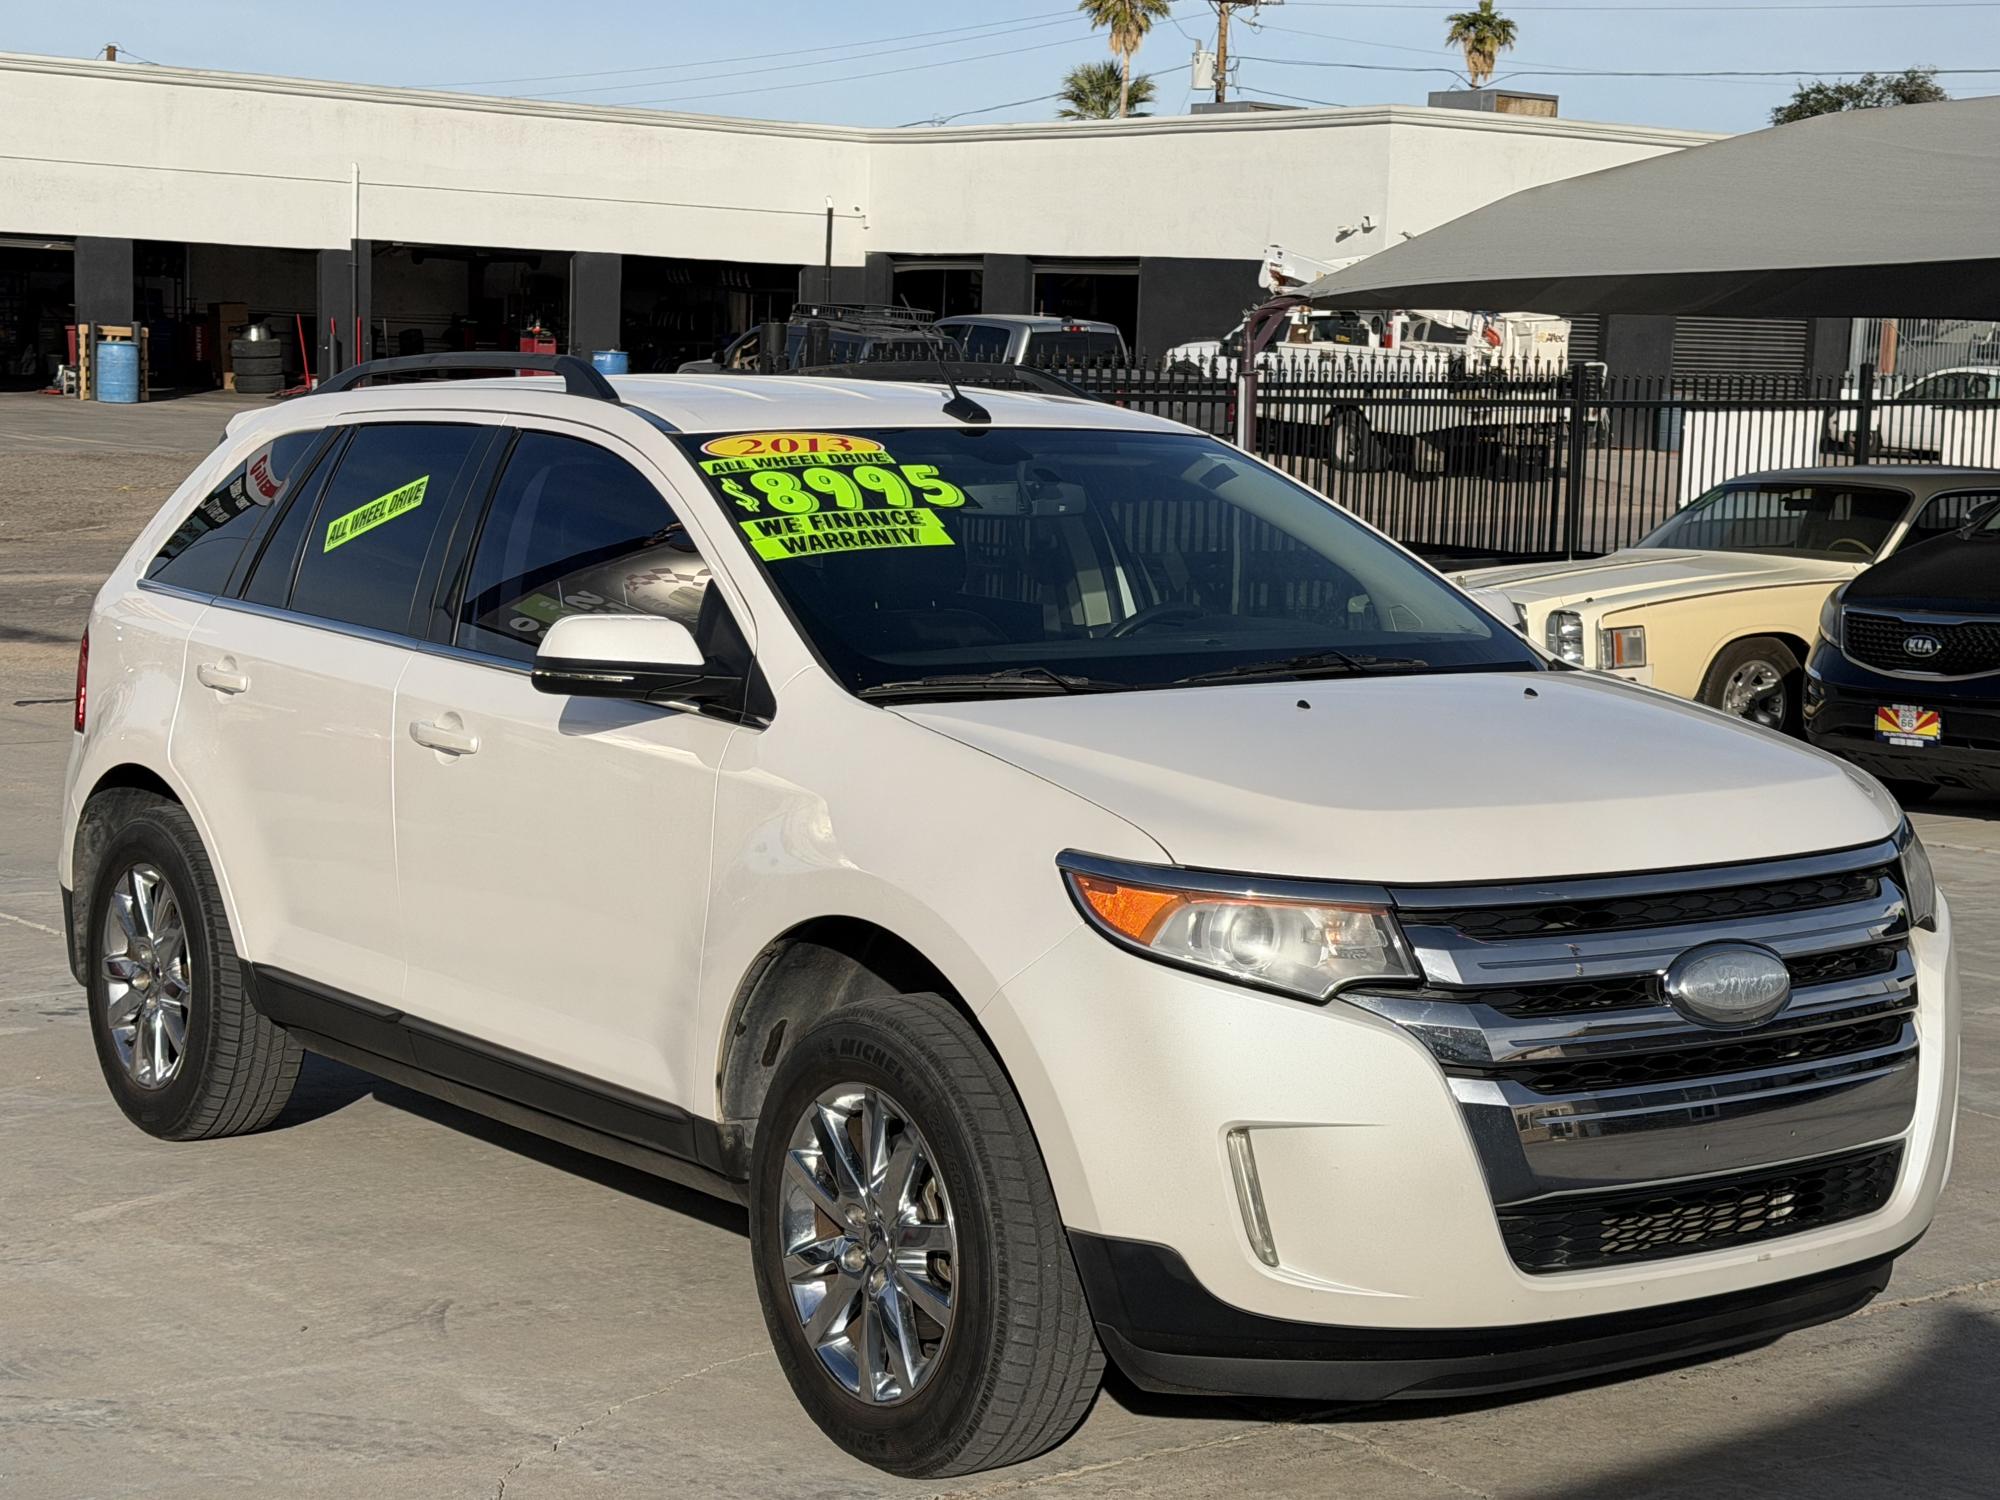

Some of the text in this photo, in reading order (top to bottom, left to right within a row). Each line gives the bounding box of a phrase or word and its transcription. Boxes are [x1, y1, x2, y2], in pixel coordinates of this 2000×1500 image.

[737, 438, 853, 455] 2013
[712, 452, 887, 475] ALL WHEEL DRIVE
[720, 464, 966, 514] $8995
[327, 481, 426, 546] ALL WHEEL DRIVE
[754, 510, 924, 538] WE FINANCE
[779, 528, 921, 554] WARRANTY
[1908, 639, 1933, 653] KIA
[1901, 719, 1914, 728] 66
